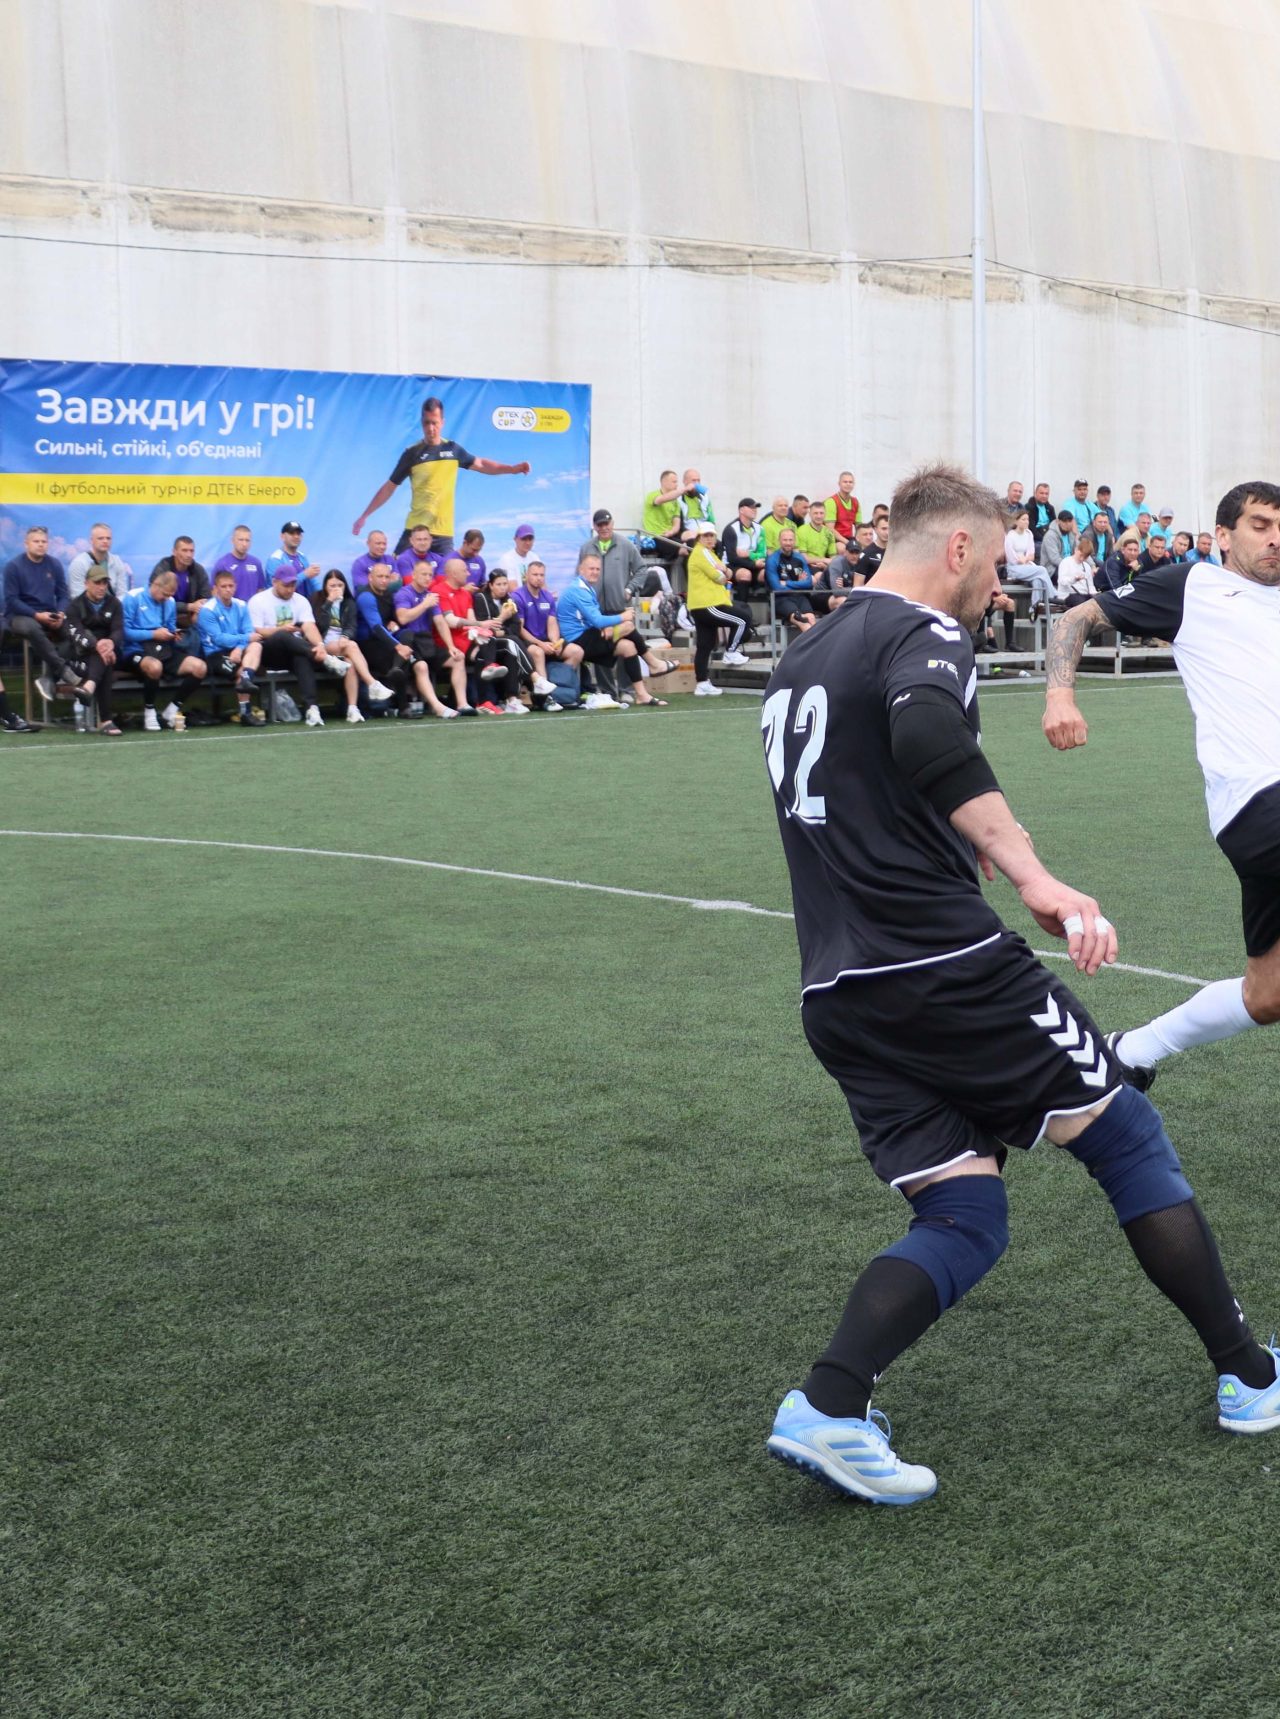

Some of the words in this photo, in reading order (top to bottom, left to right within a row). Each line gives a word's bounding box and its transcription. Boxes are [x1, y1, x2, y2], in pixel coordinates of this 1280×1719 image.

[36, 388, 206, 431] Завжди
[218, 400, 242, 436] у
[253, 394, 315, 437] грі!
[35, 438, 108, 458] Сильні,
[111, 438, 172, 459] стійкі,
[49, 481, 146, 498] футбольний
[151, 482, 203, 499] турнір
[206, 483, 244, 498] ДТЕК
[248, 483, 296, 499] Енерго
